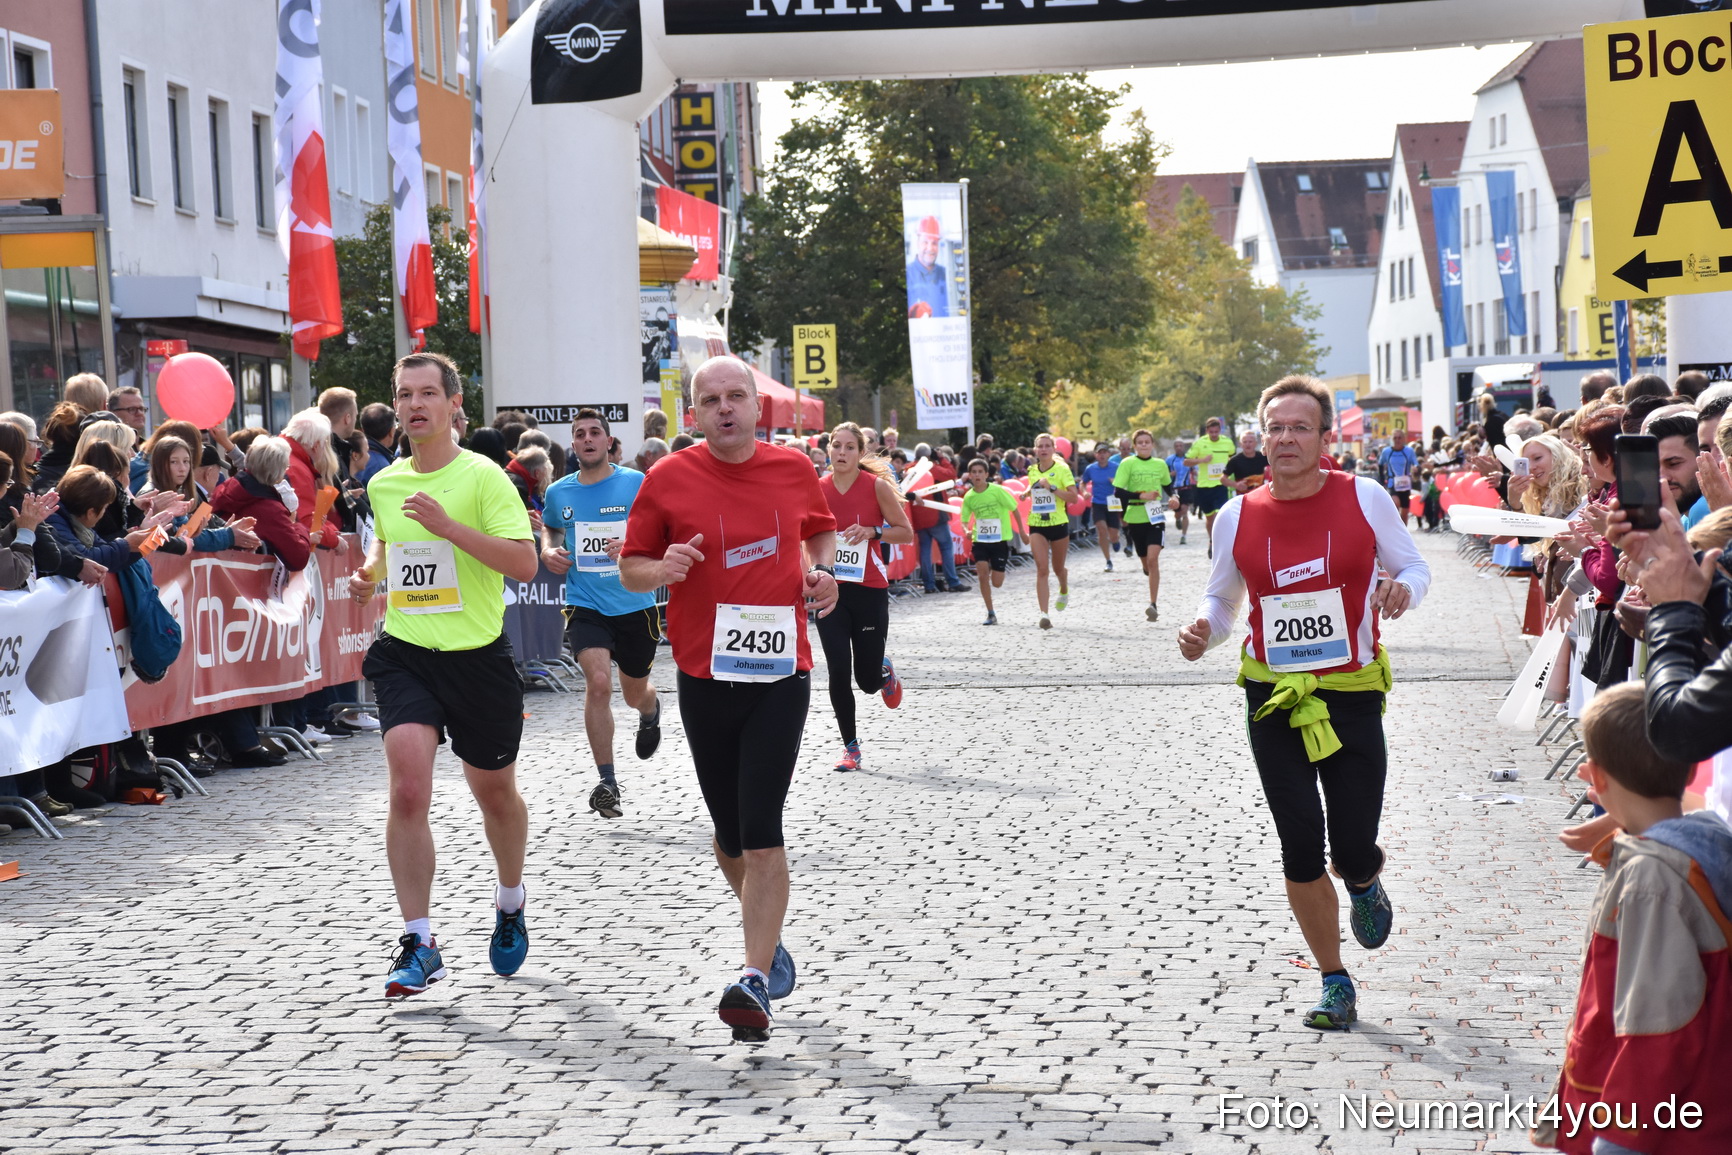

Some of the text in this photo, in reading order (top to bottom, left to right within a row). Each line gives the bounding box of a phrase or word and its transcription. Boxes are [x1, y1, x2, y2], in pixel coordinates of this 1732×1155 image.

[571, 37, 599, 49] MINI
[1608, 21, 1732, 82] Bloc
[1633, 99, 1732, 237] A
[799, 327, 831, 339] Block
[1599, 313, 1615, 344] E
[805, 345, 826, 374] B
[1080, 411, 1092, 428] C
[600, 506, 626, 514] BOCK
[980, 526, 998, 534] 2517
[582, 536, 620, 553] 205
[740, 546, 763, 559] DEHN
[835, 550, 859, 564] 050
[401, 564, 437, 586] 207
[1289, 566, 1311, 579] DEHN
[407, 593, 439, 602] Christian
[1290, 599, 1317, 608] BOCK
[1274, 615, 1334, 643] 2088
[726, 629, 786, 654] 2430
[1291, 648, 1323, 659] Markus
[734, 660, 775, 670] Johannes
